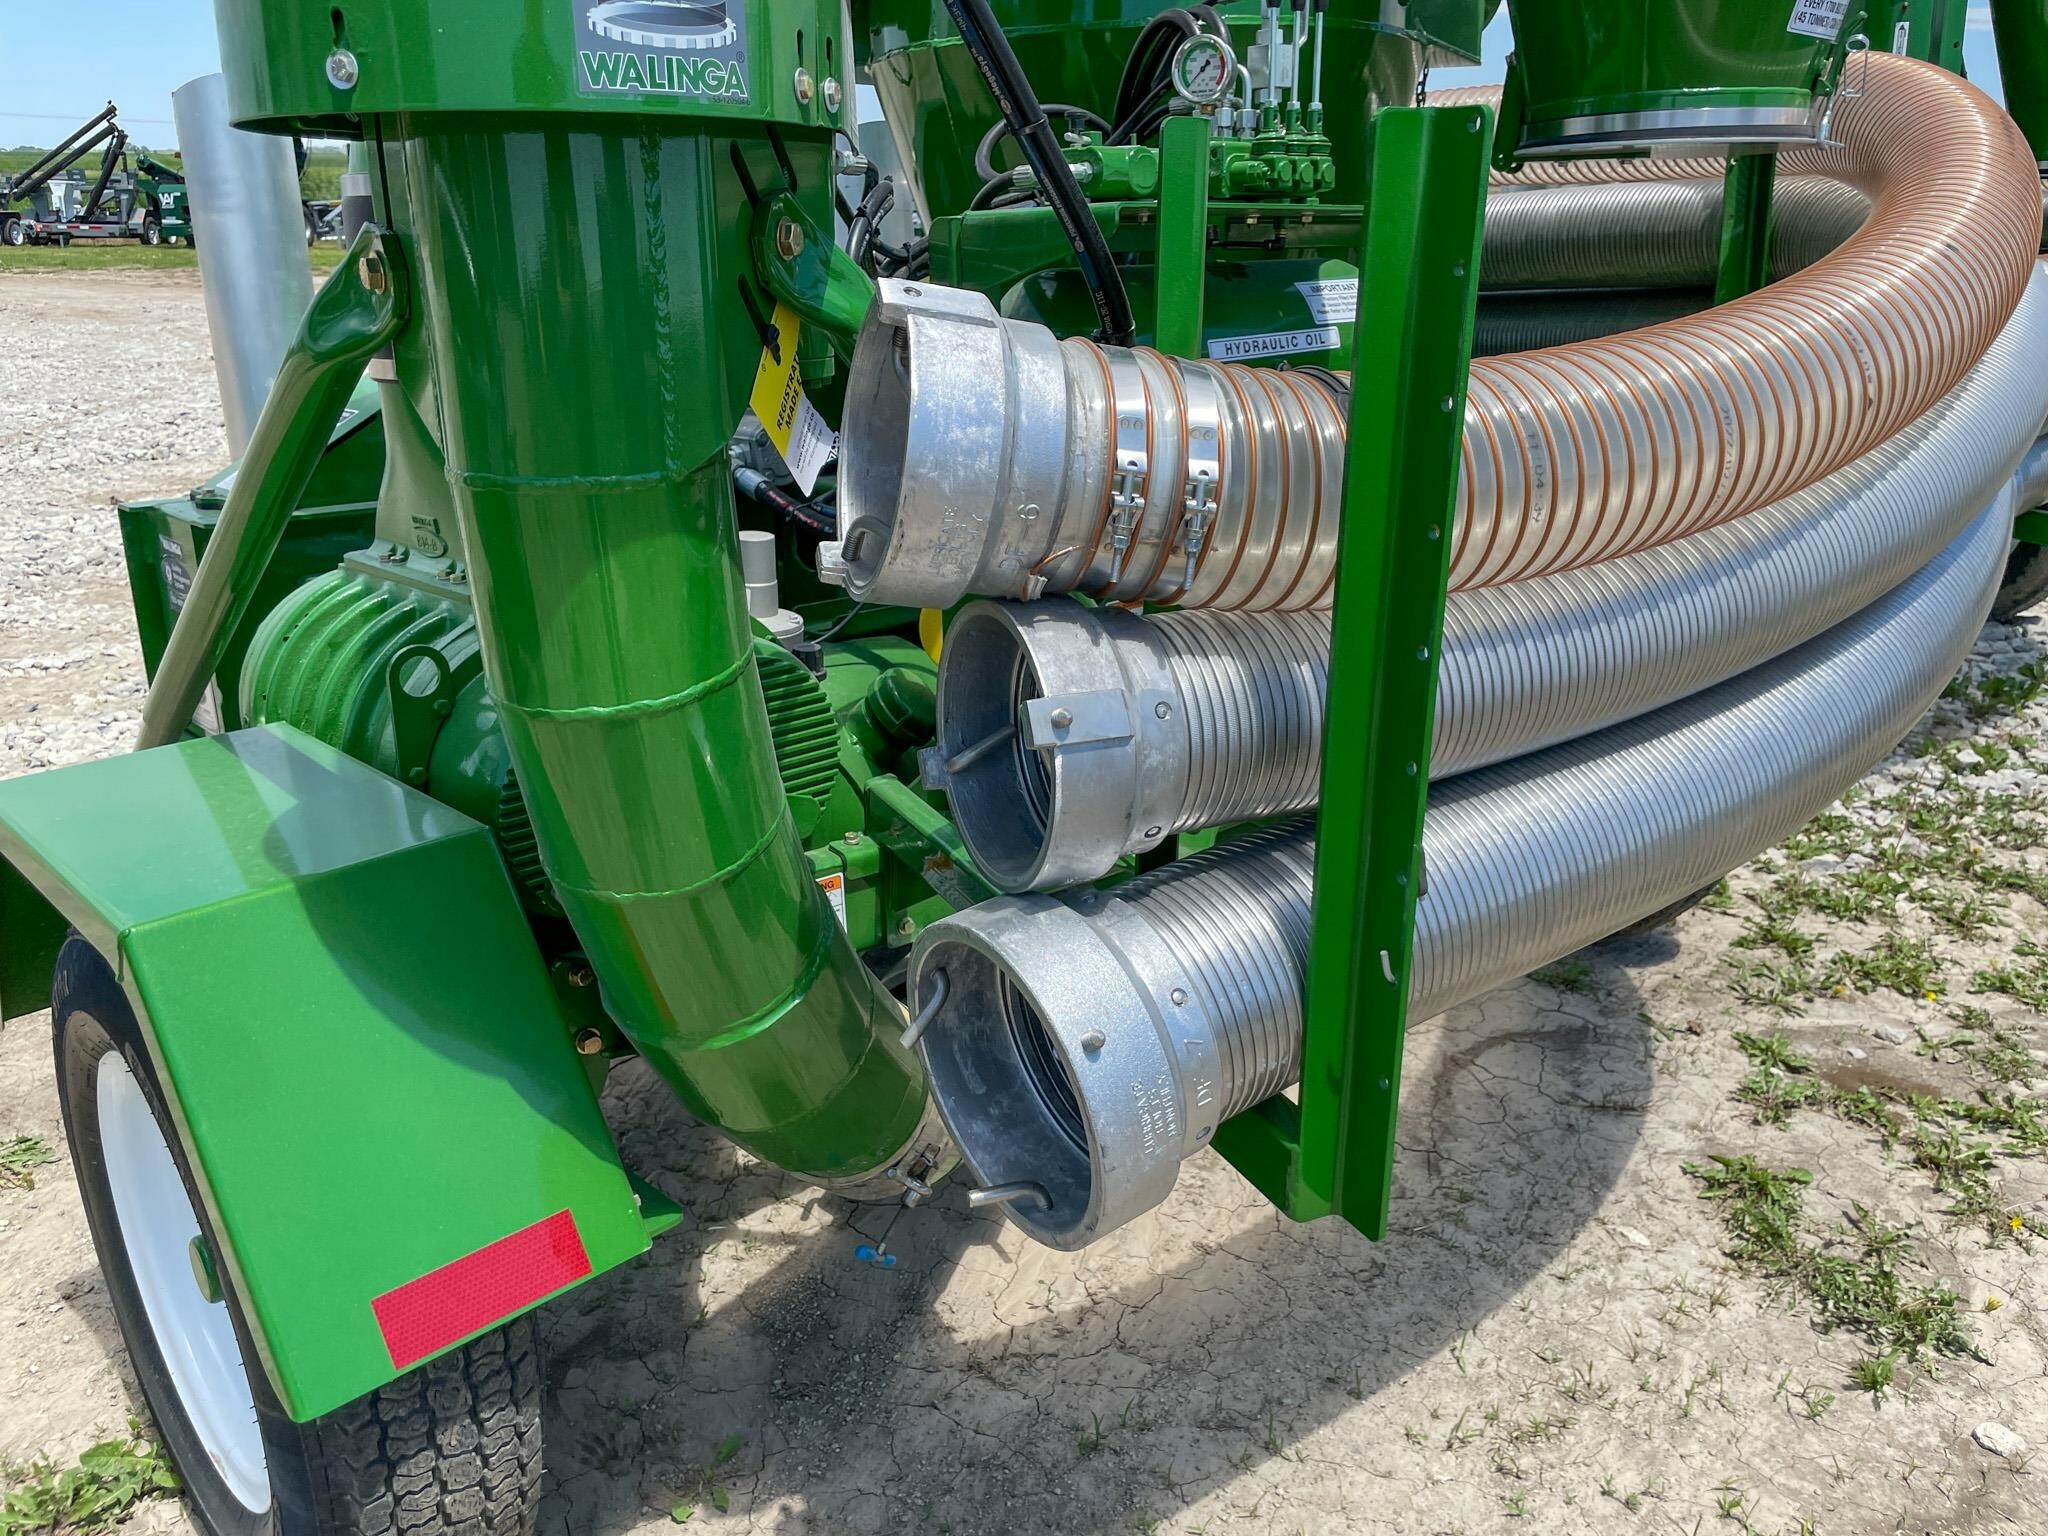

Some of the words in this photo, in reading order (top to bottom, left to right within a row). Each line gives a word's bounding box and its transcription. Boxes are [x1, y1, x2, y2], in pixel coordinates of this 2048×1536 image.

[580, 51, 748, 97] WALINGA
[1224, 335, 1299, 356] HYDRAULIC
[1306, 333, 1326, 346] OIL
[785, 391, 800, 430] MADE
